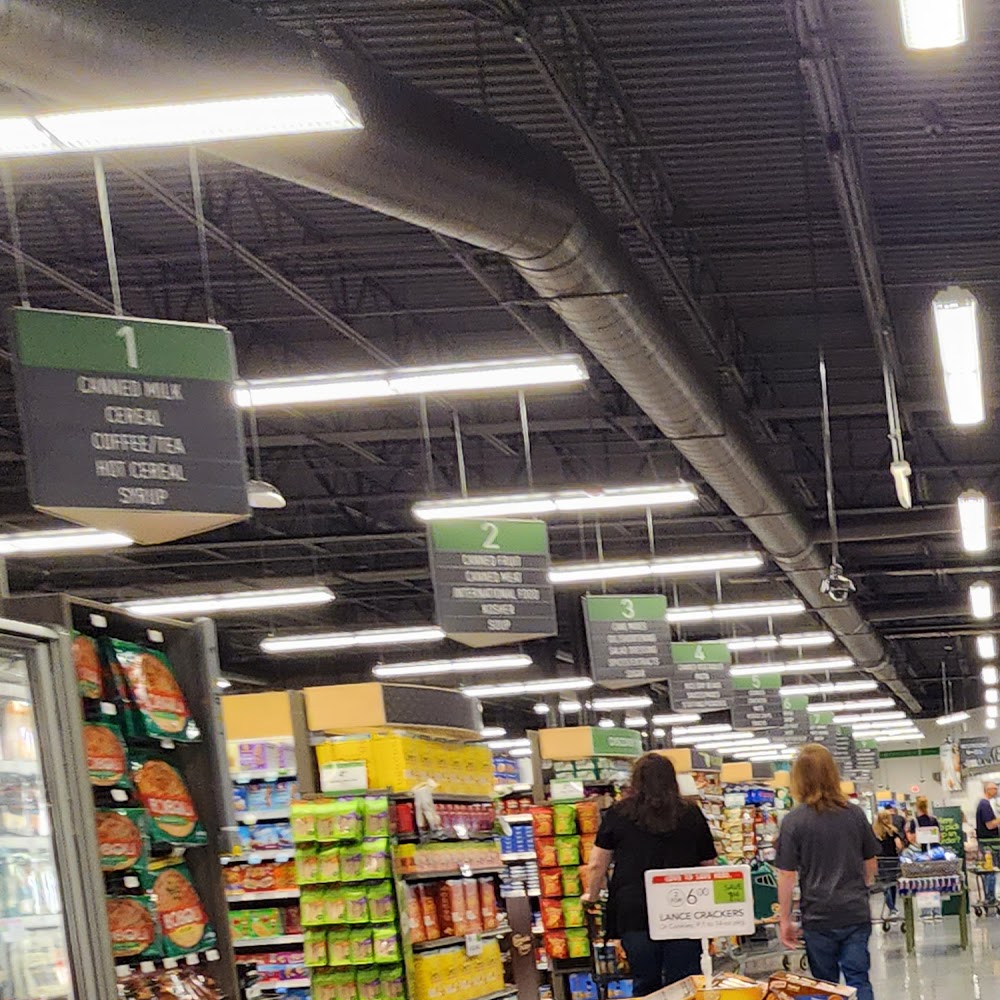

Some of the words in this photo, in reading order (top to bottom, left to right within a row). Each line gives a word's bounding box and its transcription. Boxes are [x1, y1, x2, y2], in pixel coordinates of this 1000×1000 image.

[116, 326, 138, 368] 1
[77, 375, 142, 397] CANNED
[142, 381, 184, 400] MILK
[104, 405, 165, 427] CEREAL
[90, 432, 186, 455] COFFEE/TEA
[95, 459, 127, 478] HOT
[129, 461, 188, 482] CEREAL
[481, 522, 500, 549] 2
[620, 598, 635, 619] 3
[486, 618, 512, 631] SOUP
[694, 644, 705, 660] 4
[751, 674, 761, 689] 5
[783, 697, 792, 710] 6
[659, 911, 692, 921] LANCE
[694, 908, 745, 919] CRACKERS
